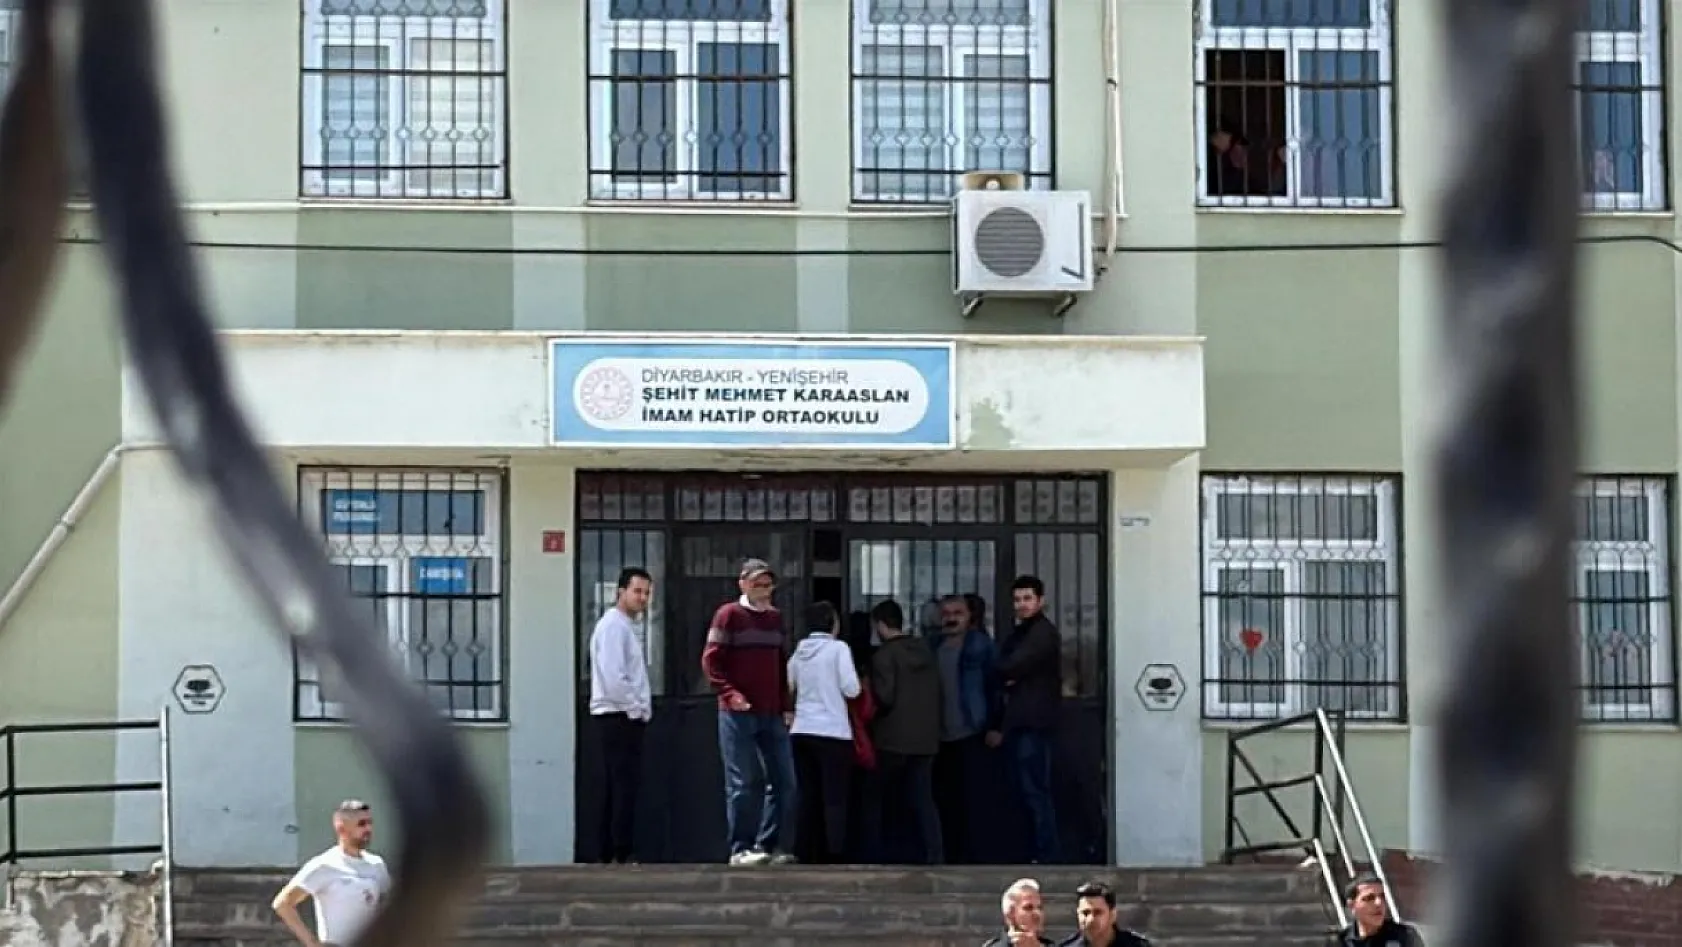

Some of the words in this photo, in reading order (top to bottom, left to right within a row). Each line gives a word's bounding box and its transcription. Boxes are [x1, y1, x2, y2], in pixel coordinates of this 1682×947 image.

[642, 367, 743, 384] DİYARBAKIR
[757, 367, 849, 387] YENİŞEHİR
[642, 386, 698, 404] ŞEHİT
[705, 388, 786, 402] MEHMET
[794, 389, 910, 403] KARAASLAN
[642, 406, 694, 422] İMAM
[699, 407, 757, 423] HATİP
[763, 410, 880, 424] ORTAOKULU
